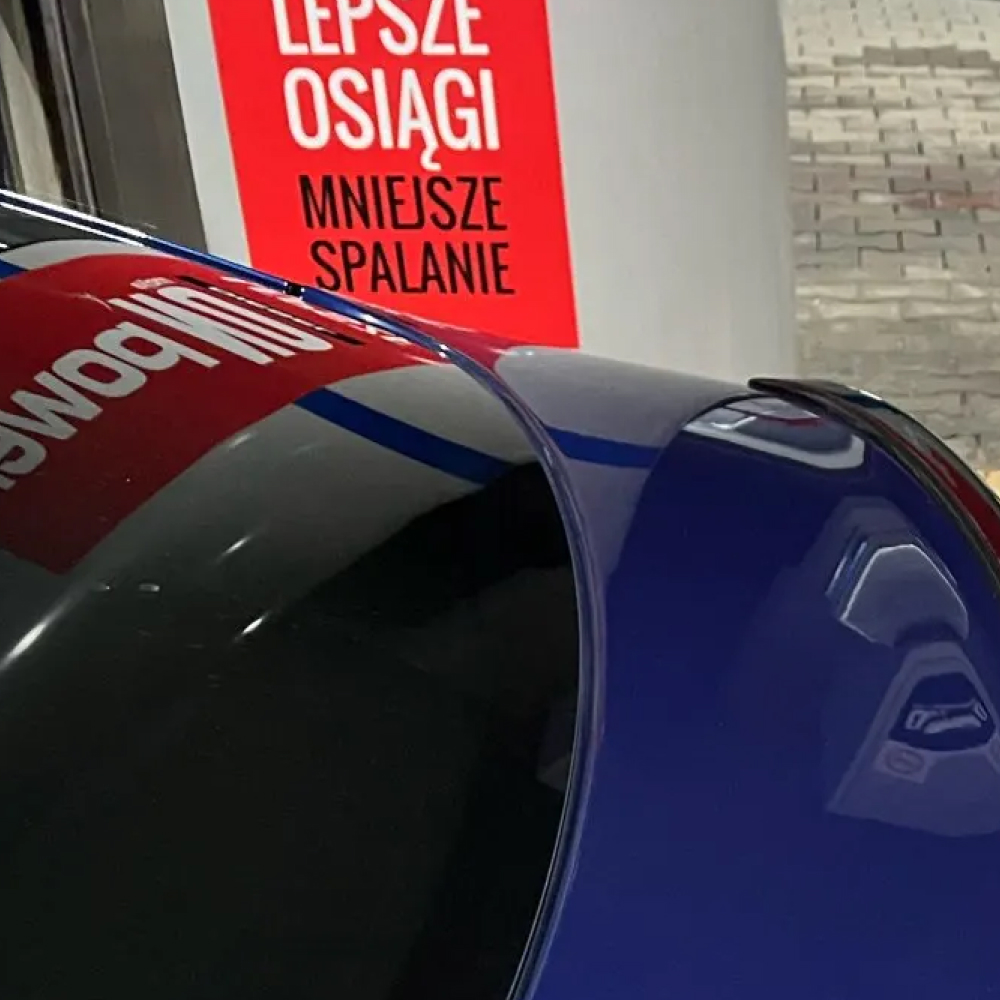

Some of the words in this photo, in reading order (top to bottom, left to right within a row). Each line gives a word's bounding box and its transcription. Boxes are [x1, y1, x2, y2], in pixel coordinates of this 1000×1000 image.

[272, 0, 490, 56] LEPSZE
[283, 67, 500, 171] OSIĄGI
[299, 175, 508, 231] MNIEJSZE
[310, 240, 516, 295] SPALANIE
